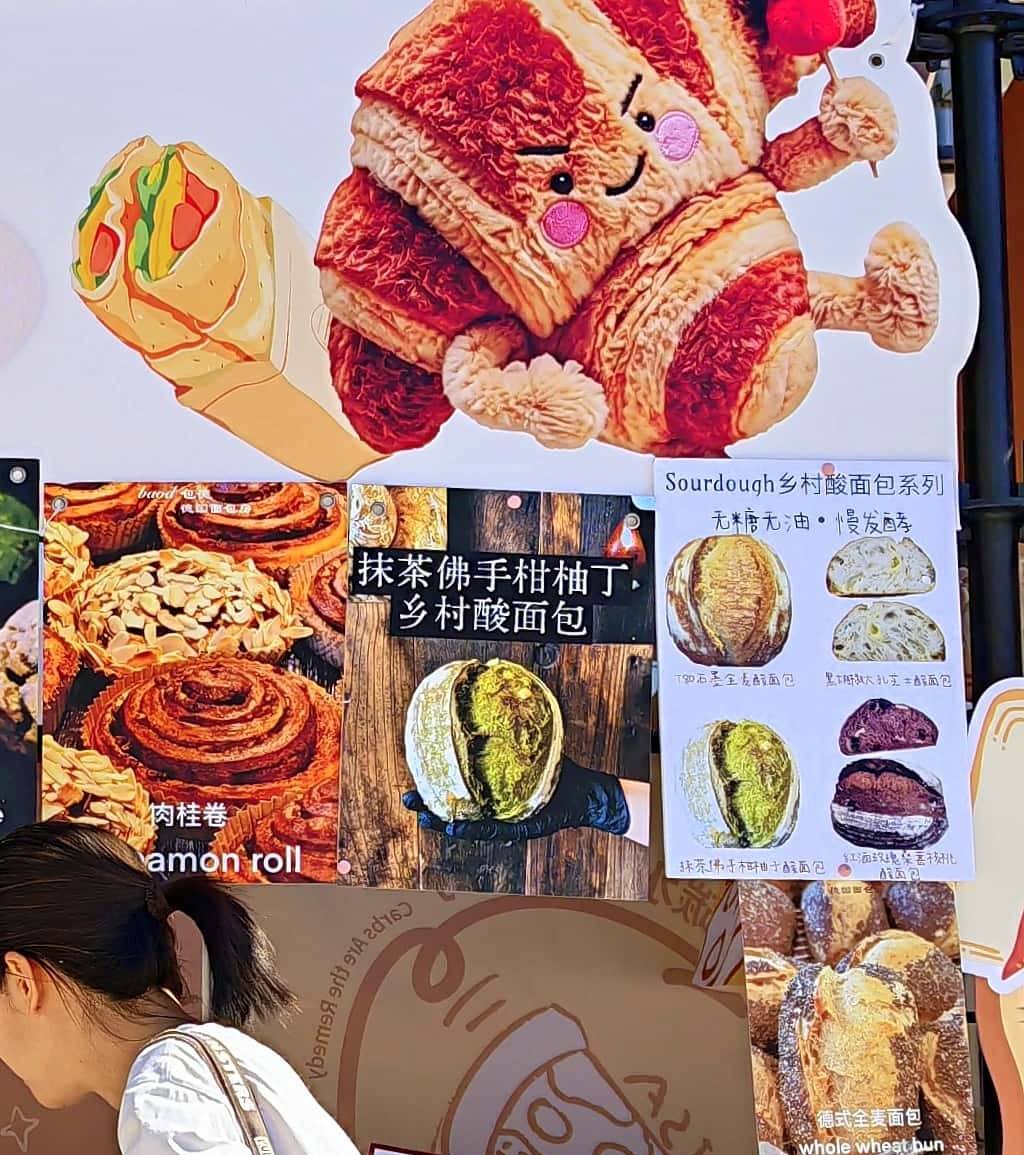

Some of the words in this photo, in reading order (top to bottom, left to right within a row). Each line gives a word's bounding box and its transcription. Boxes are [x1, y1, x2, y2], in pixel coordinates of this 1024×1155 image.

[665, 471, 945, 498] Sourdough乡村酸面包系列
[711, 507, 811, 534] 无糖无油
[835, 508, 913, 535] 慢发酵
[357, 551, 629, 598] 抹茶佛手柑柚丁
[398, 593, 588, 637] 乡村酸面包
[149, 802, 228, 828] 肉桂卷
[251, 845, 302, 873] roll
[816, 1107, 922, 1130] 德式全麦面包
[856, 1138, 907, 1155] wheat
[911, 1138, 945, 1152] bun
